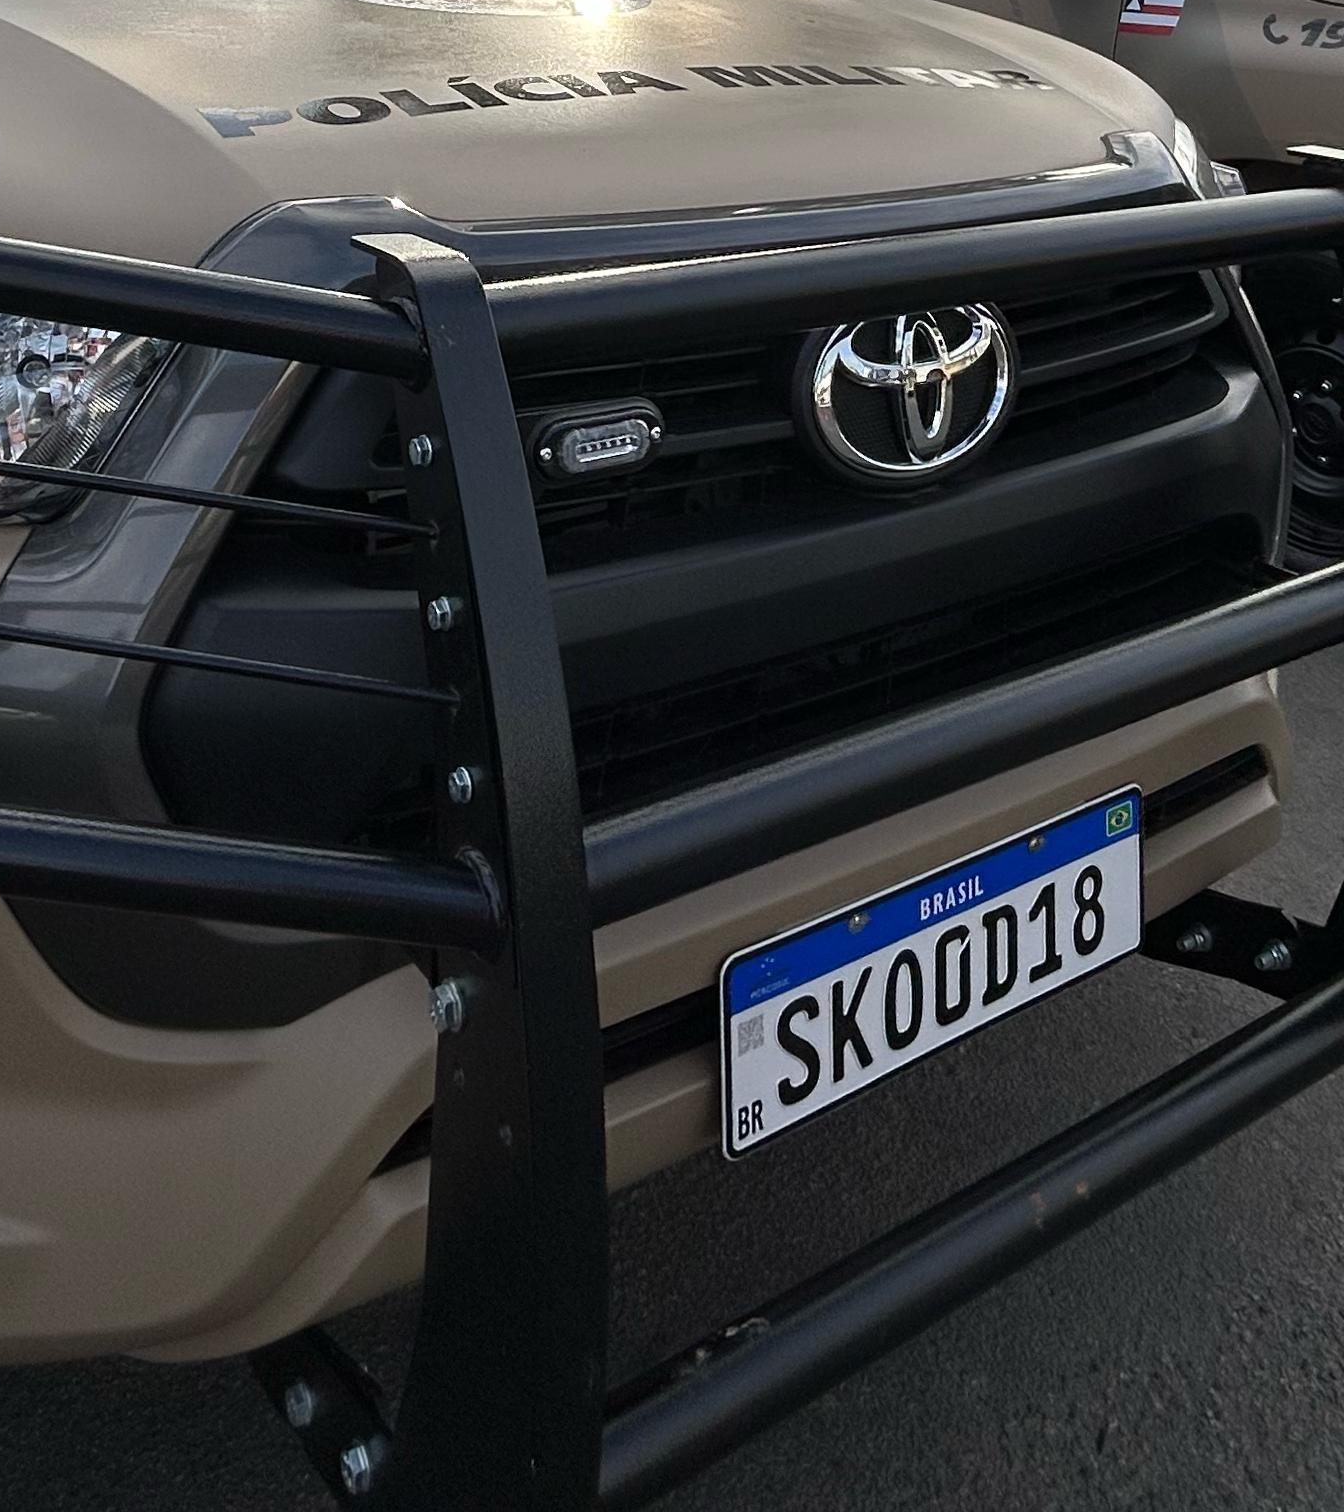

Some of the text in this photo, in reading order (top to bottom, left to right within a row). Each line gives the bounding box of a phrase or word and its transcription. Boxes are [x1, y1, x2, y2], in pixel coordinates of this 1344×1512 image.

[197, 65, 1057, 139] POLÍCIA MILITAR
[919, 875, 984, 921] BRASIL
[737, 1098, 764, 1141] BR
